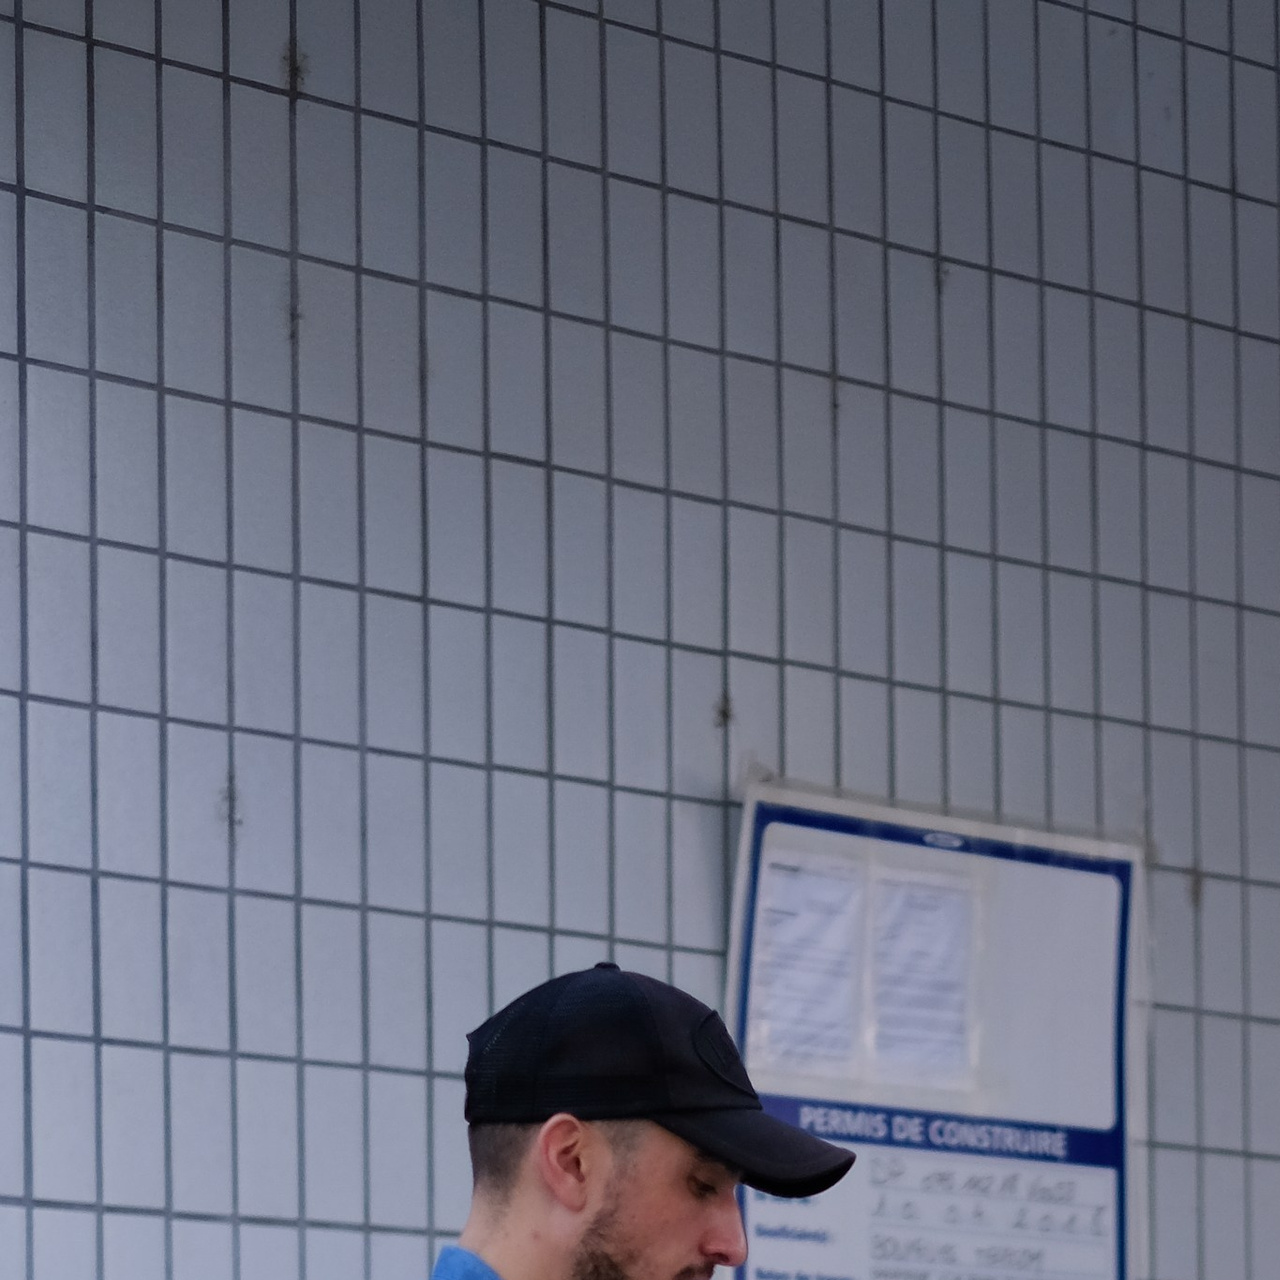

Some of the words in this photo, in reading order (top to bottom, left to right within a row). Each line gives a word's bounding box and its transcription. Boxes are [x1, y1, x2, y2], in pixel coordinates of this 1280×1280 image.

[801, 1106, 888, 1138] PERMIS
[891, 1115, 924, 1142] DE
[928, 1119, 1067, 1158] CONSTRUIRE
